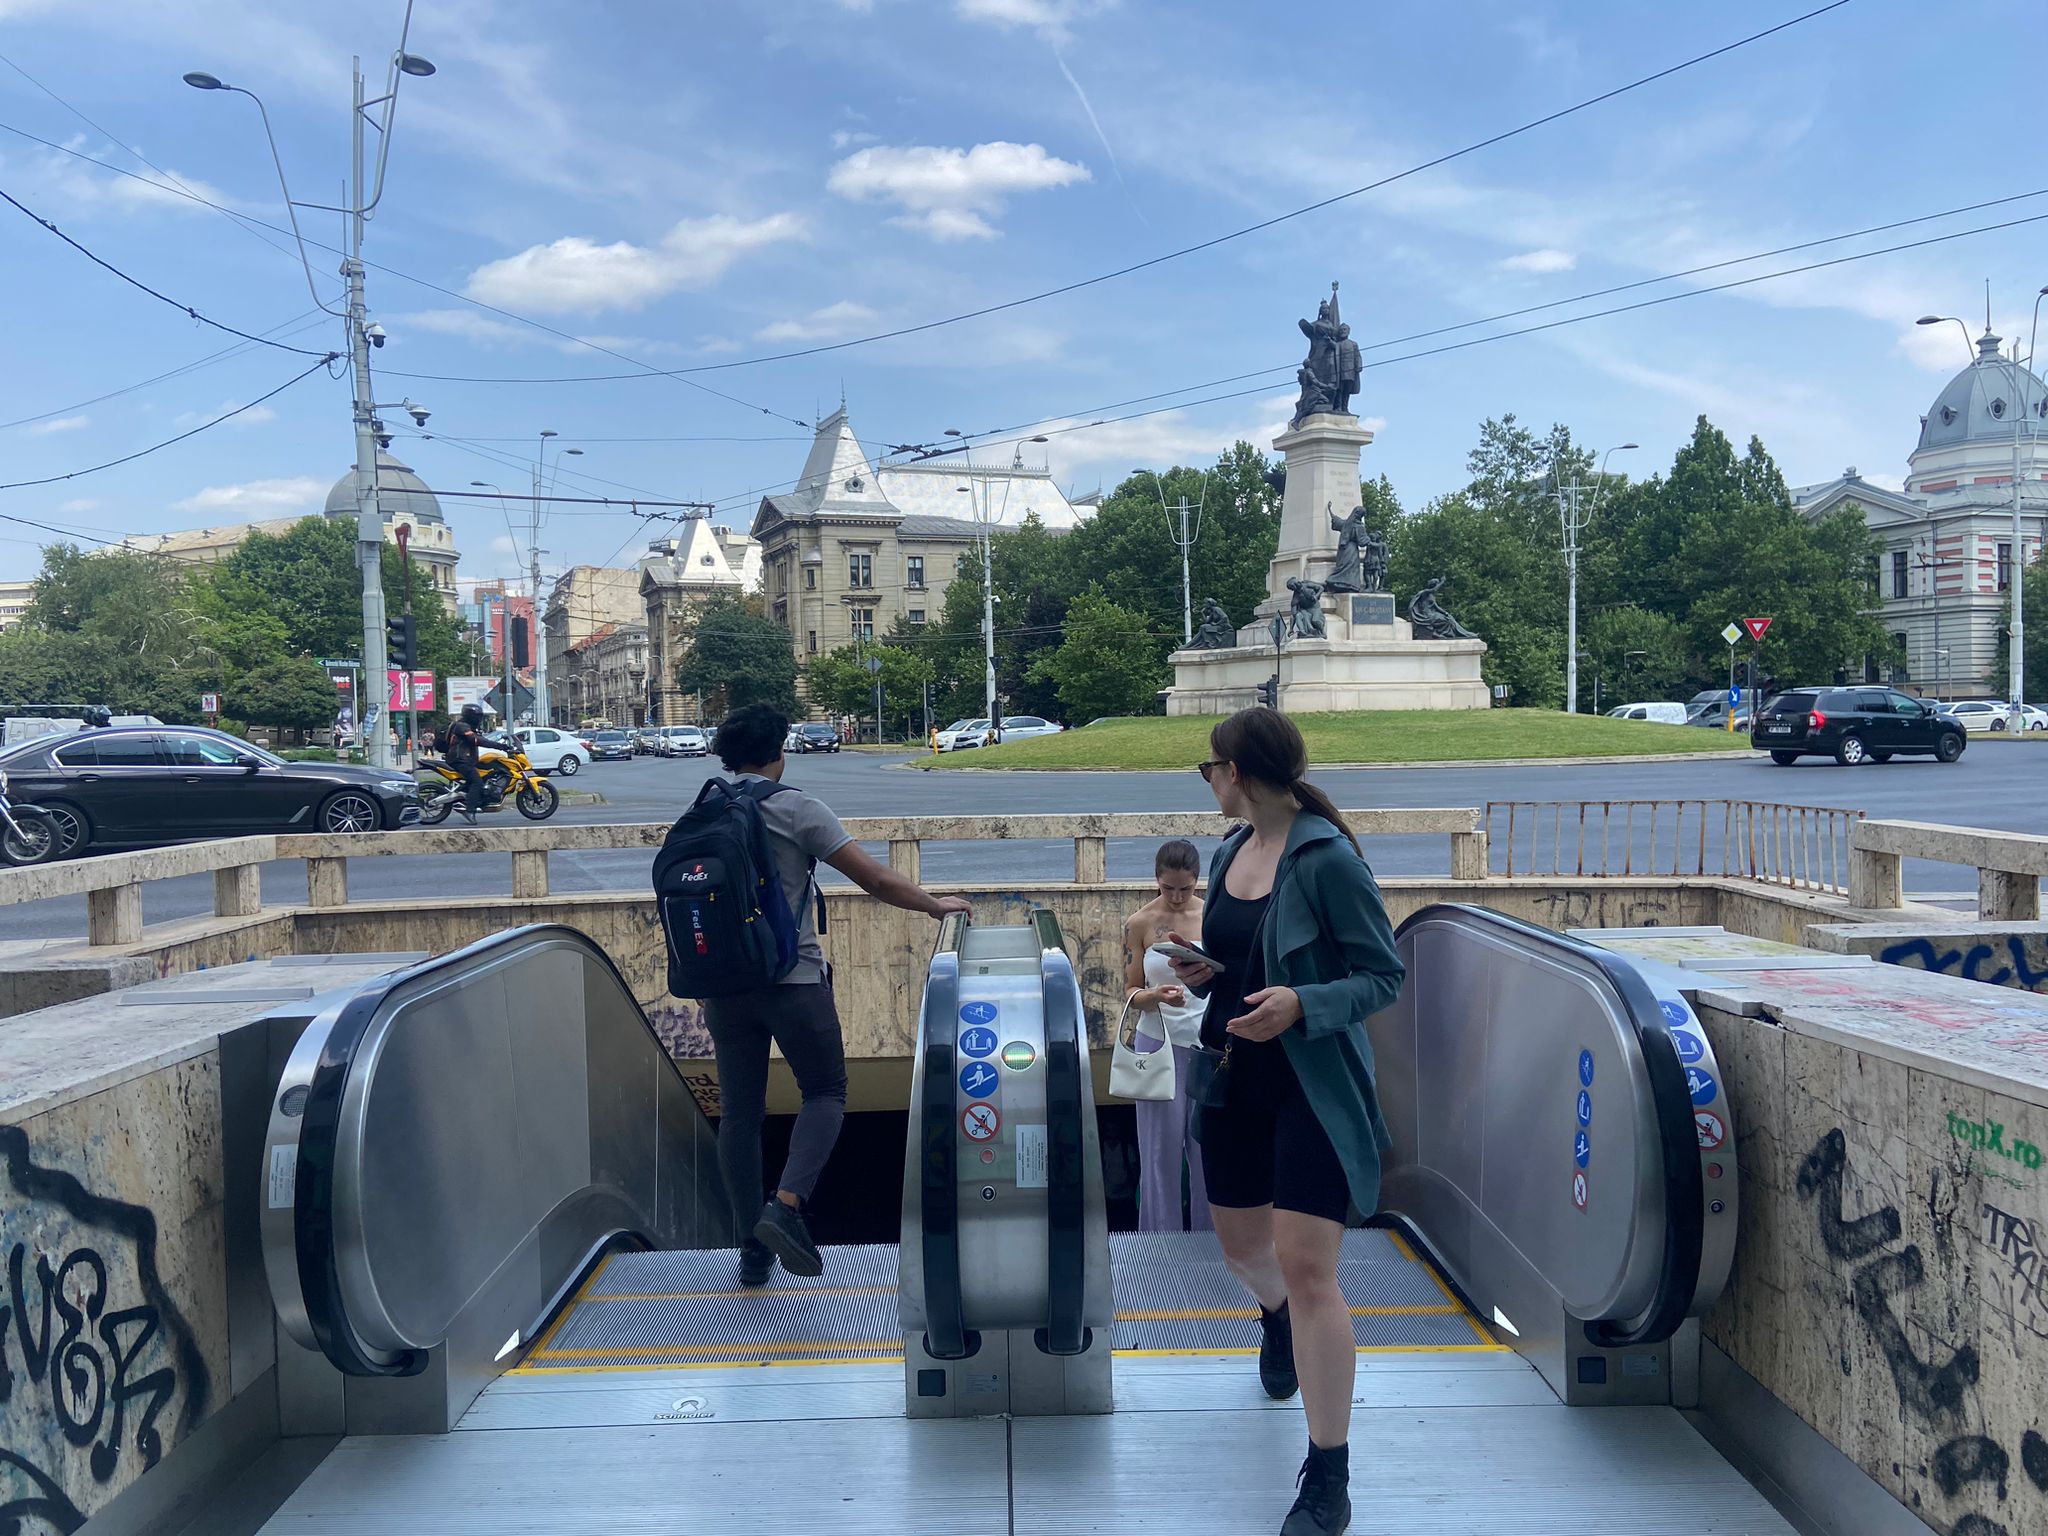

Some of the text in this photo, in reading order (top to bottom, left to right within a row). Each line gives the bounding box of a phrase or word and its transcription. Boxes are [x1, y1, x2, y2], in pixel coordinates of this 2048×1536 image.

[681, 872, 709, 881] FedEx
[1946, 1110, 2042, 1171] topX.ro
[653, 1412, 716, 1420] Schindler
